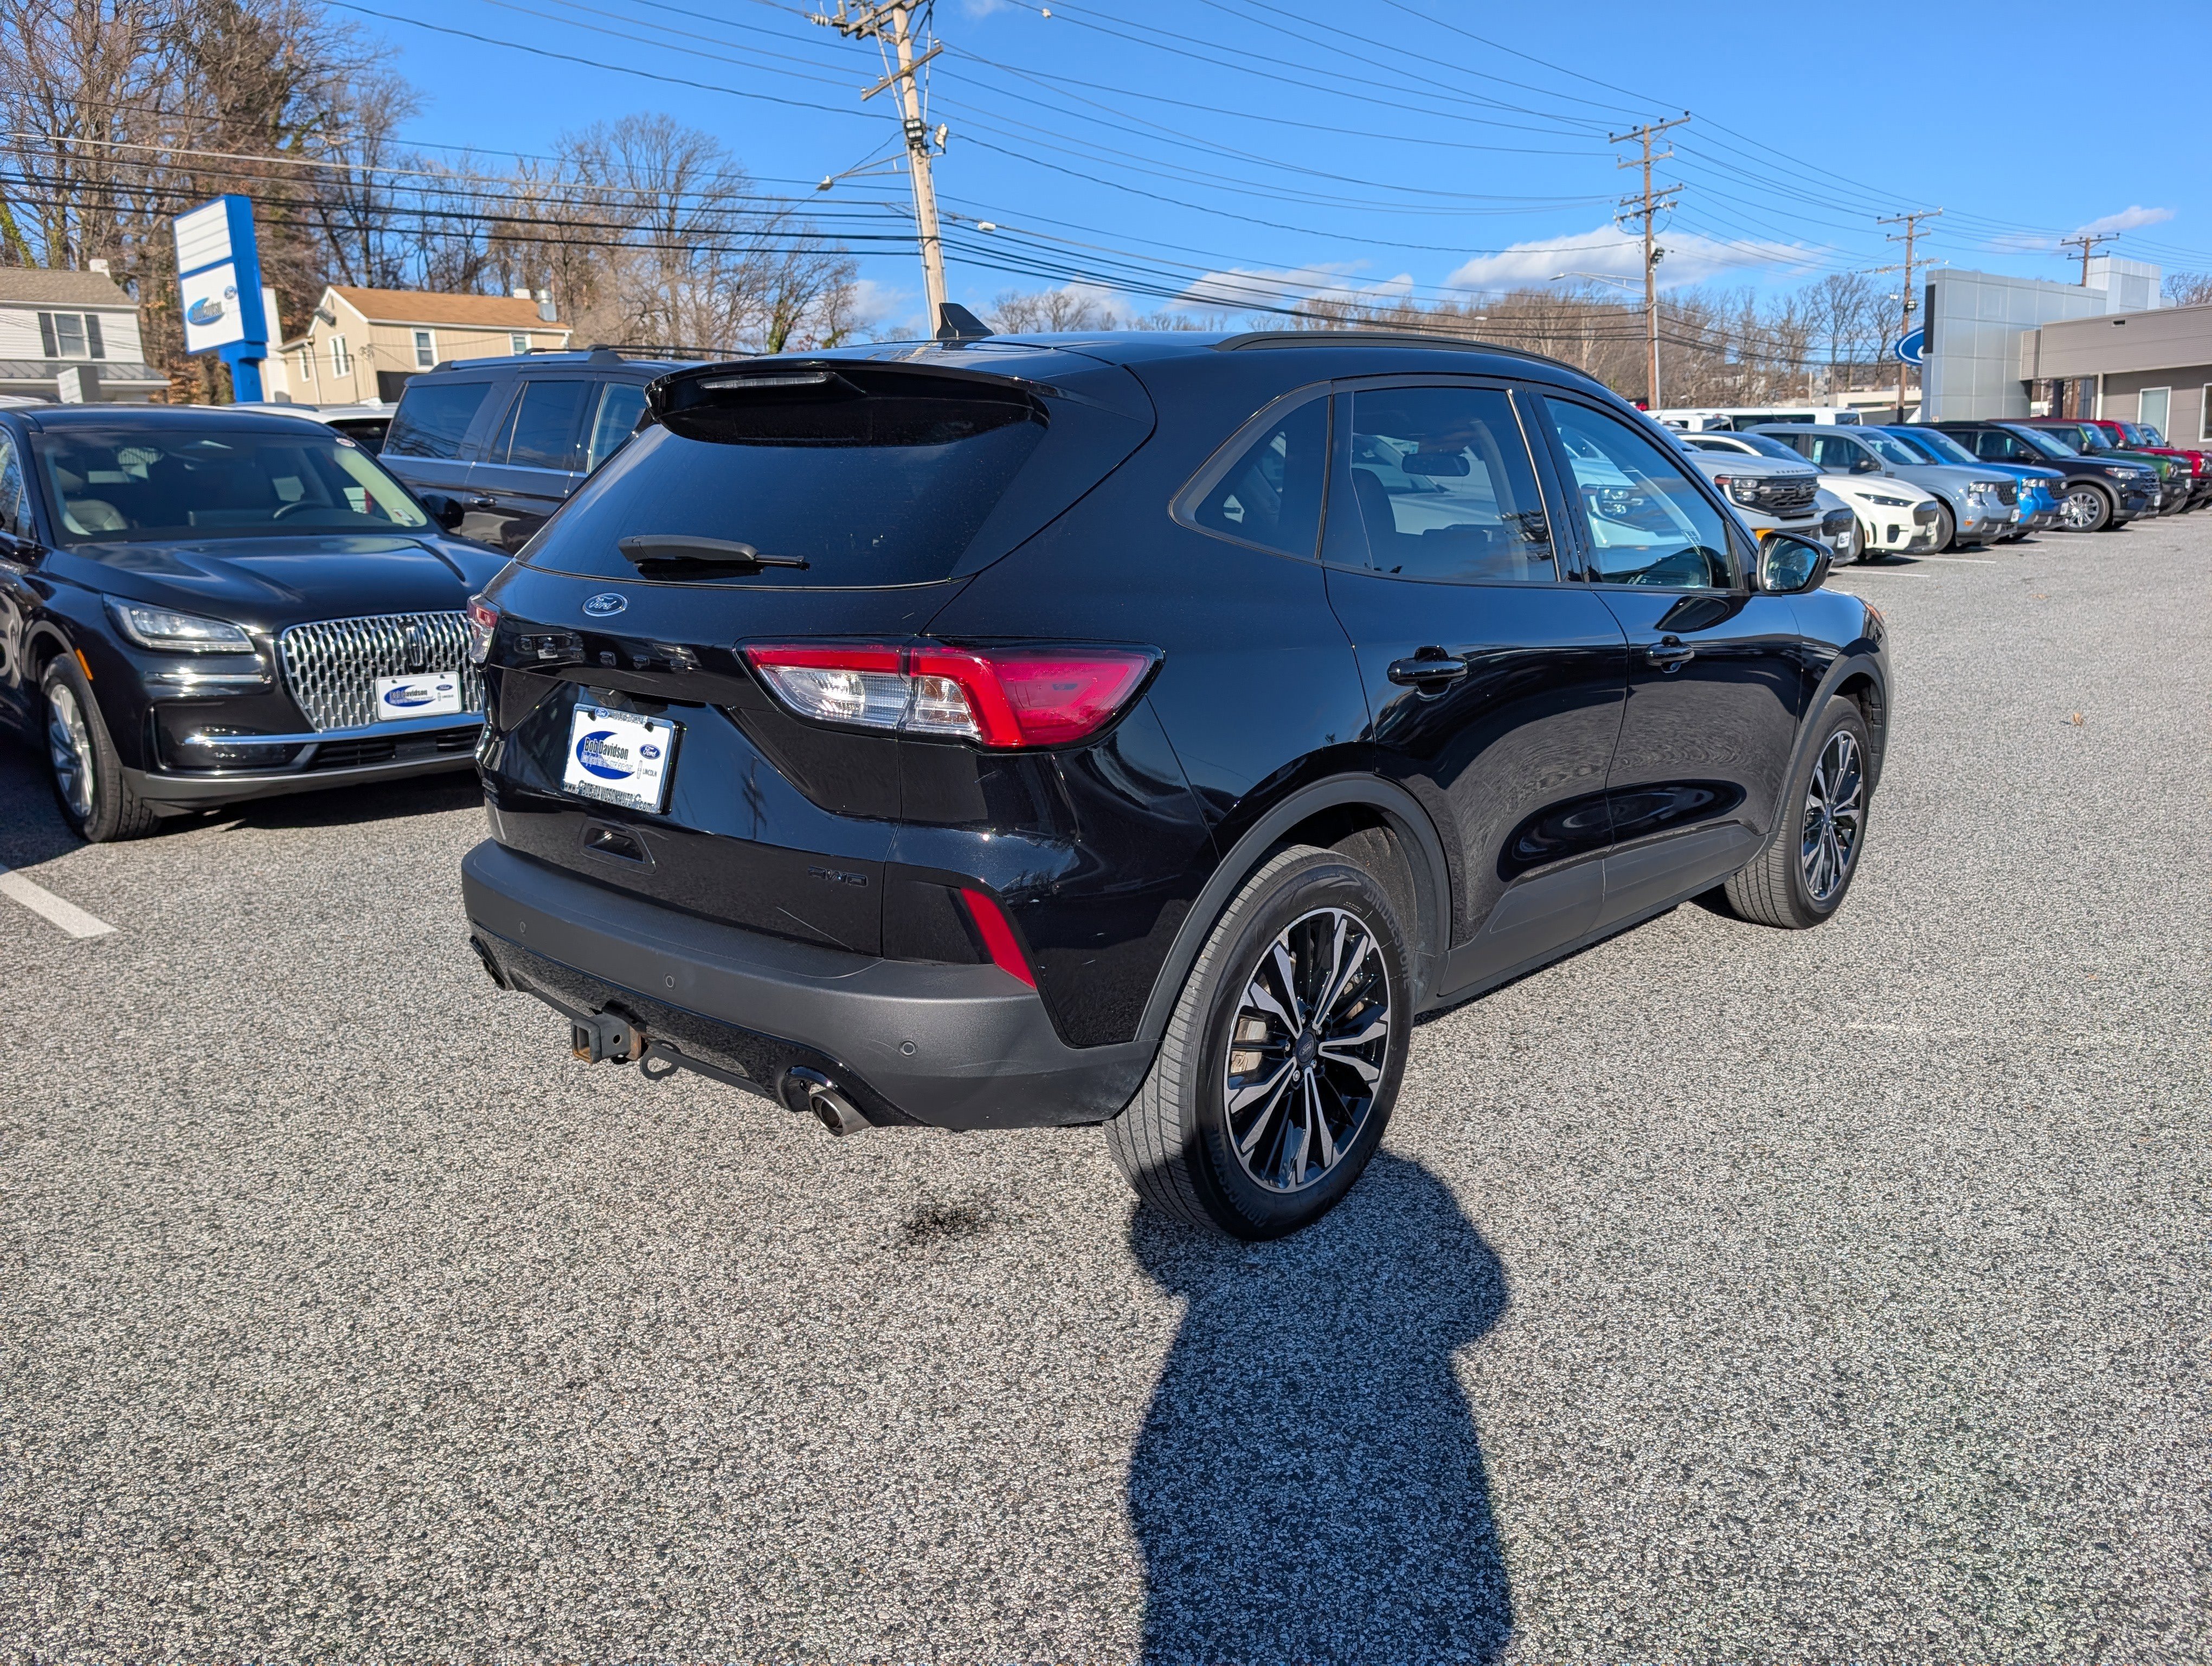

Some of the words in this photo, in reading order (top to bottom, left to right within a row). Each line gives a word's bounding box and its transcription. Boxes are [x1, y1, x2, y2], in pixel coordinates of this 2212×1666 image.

[584, 738, 598, 753] Bob
[599, 740, 629, 760] Davidson
[642, 768, 658, 777] LINCOLN
[1363, 886, 1410, 989] BRIDGESTONE
